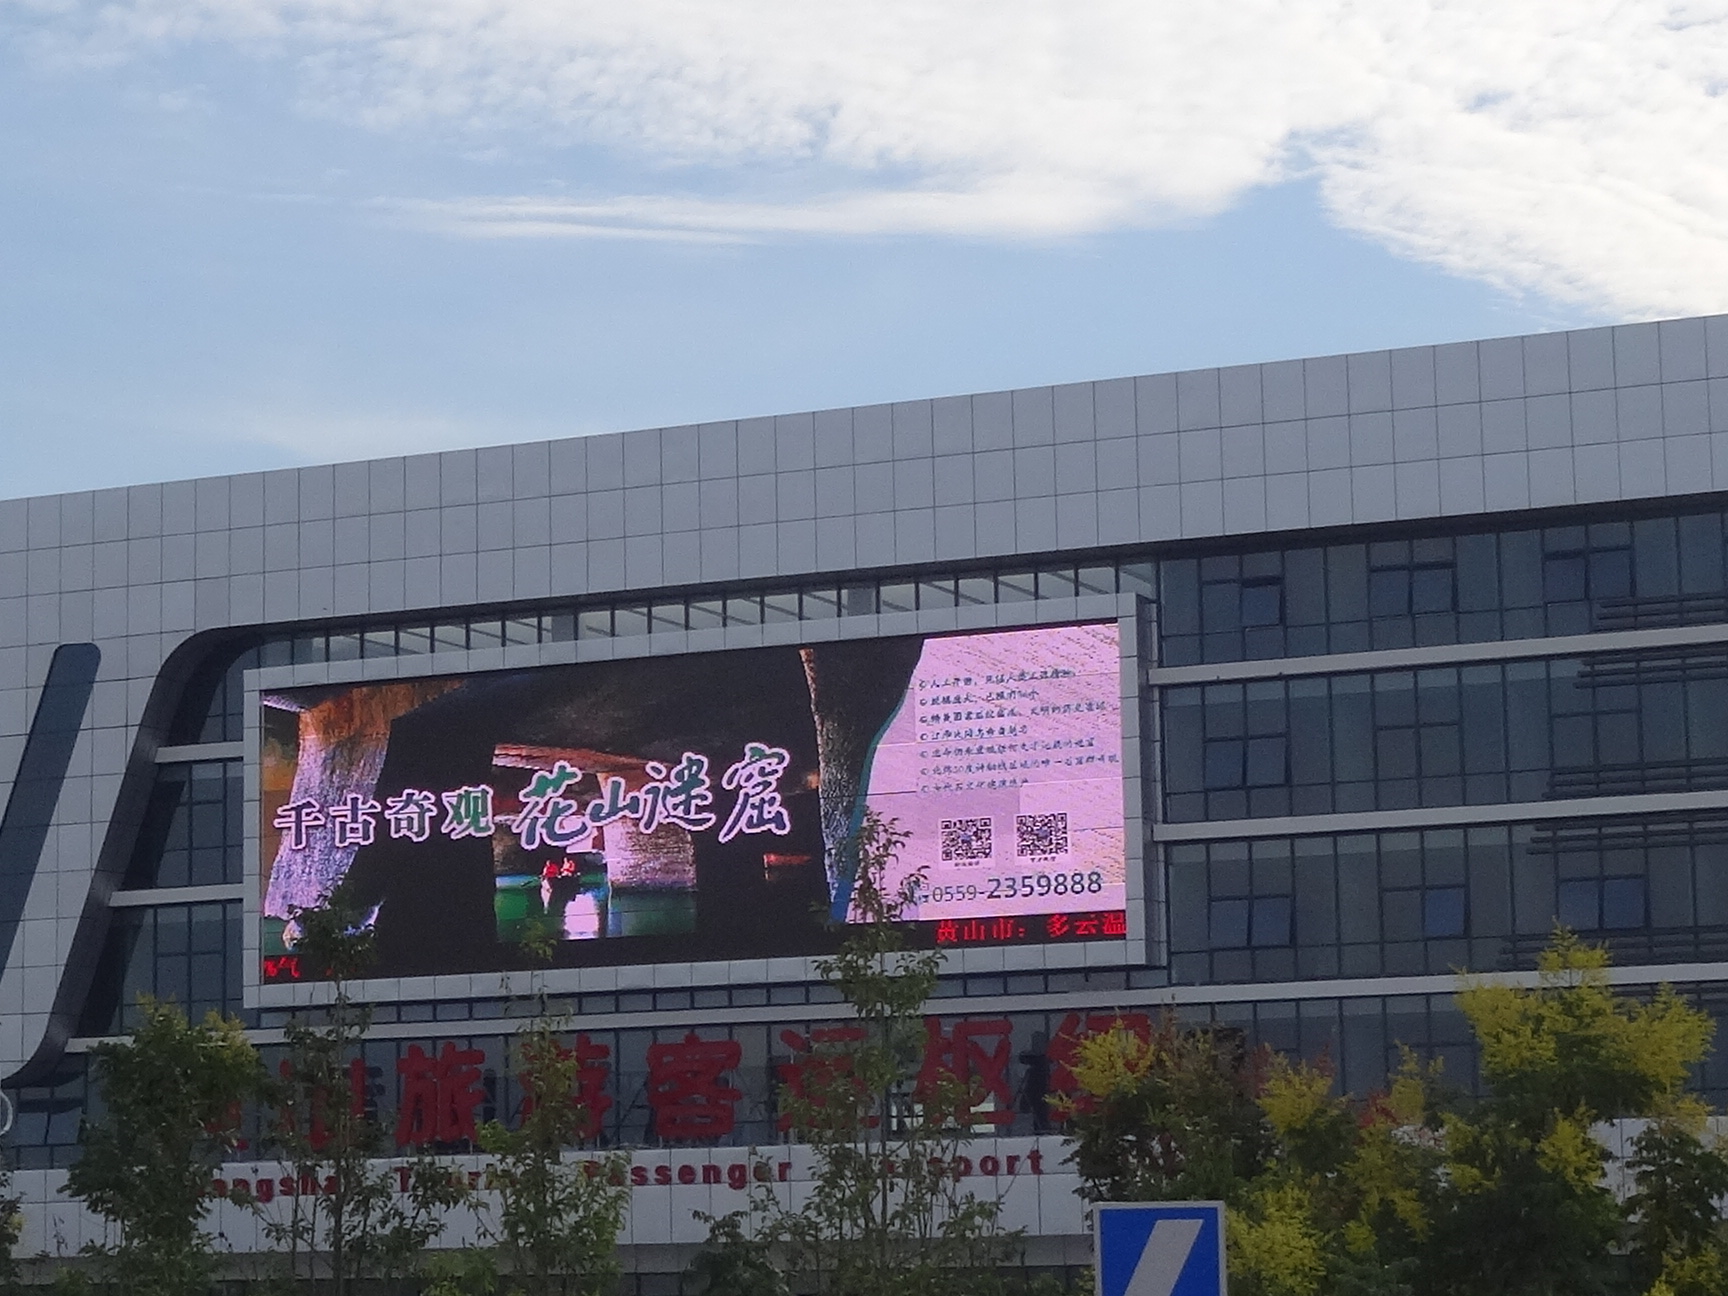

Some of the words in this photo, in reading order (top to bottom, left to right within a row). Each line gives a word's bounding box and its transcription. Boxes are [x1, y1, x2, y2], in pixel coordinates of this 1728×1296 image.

[274, 785, 495, 850] 千古奇观
[513, 742, 790, 850] 花山谜窟
[932, 871, 1103, 903] 0559-2359888
